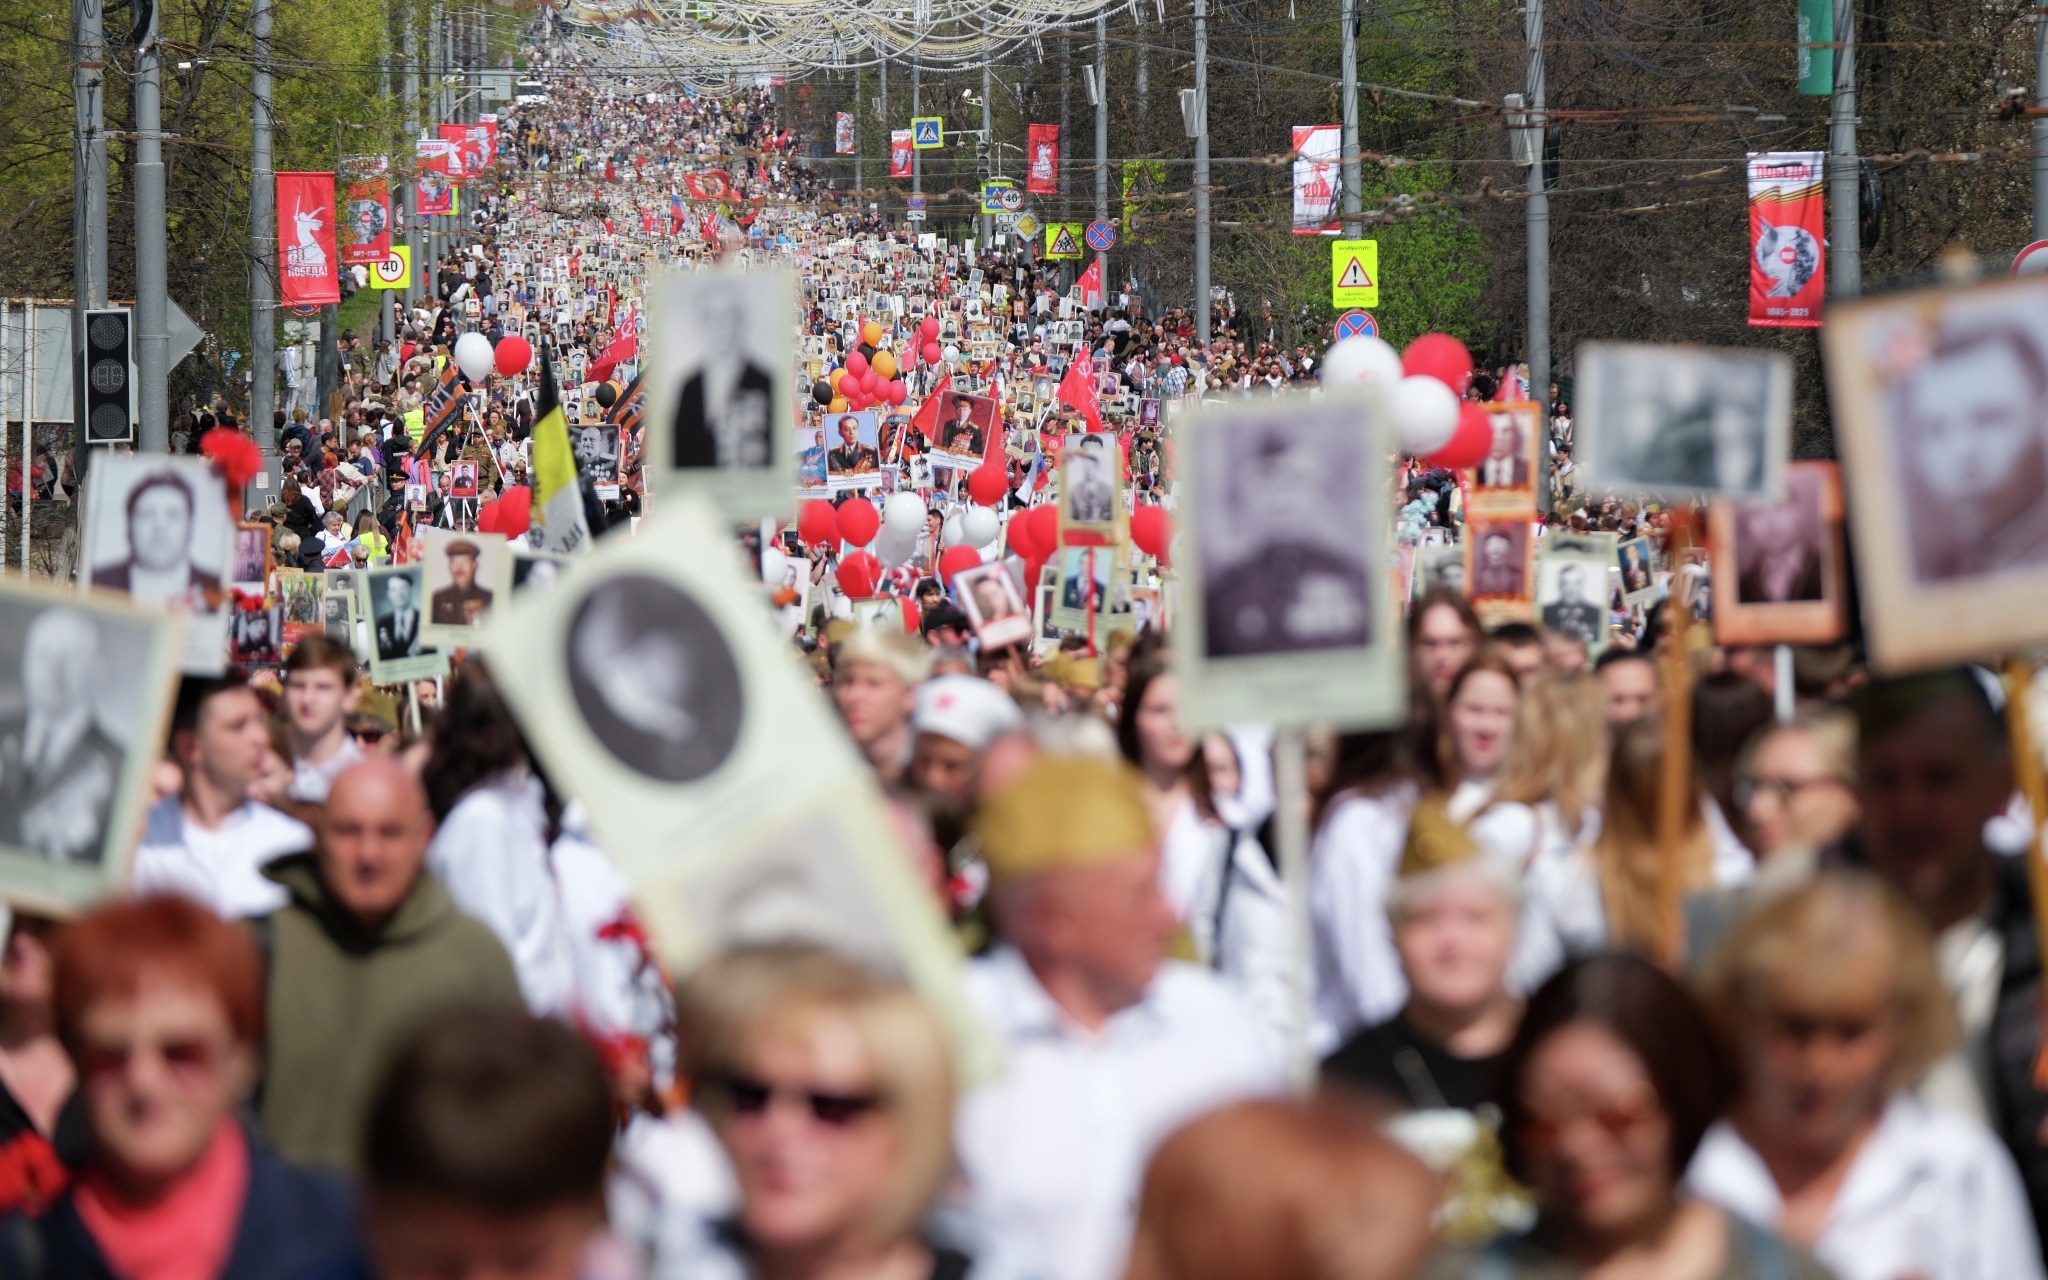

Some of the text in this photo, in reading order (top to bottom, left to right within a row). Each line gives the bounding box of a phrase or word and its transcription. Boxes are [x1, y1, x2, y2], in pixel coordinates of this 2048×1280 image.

[1005, 193, 1018, 203] 40
[287, 265, 328, 278] ПОБЕДА!
[381, 260, 399, 273] 40
